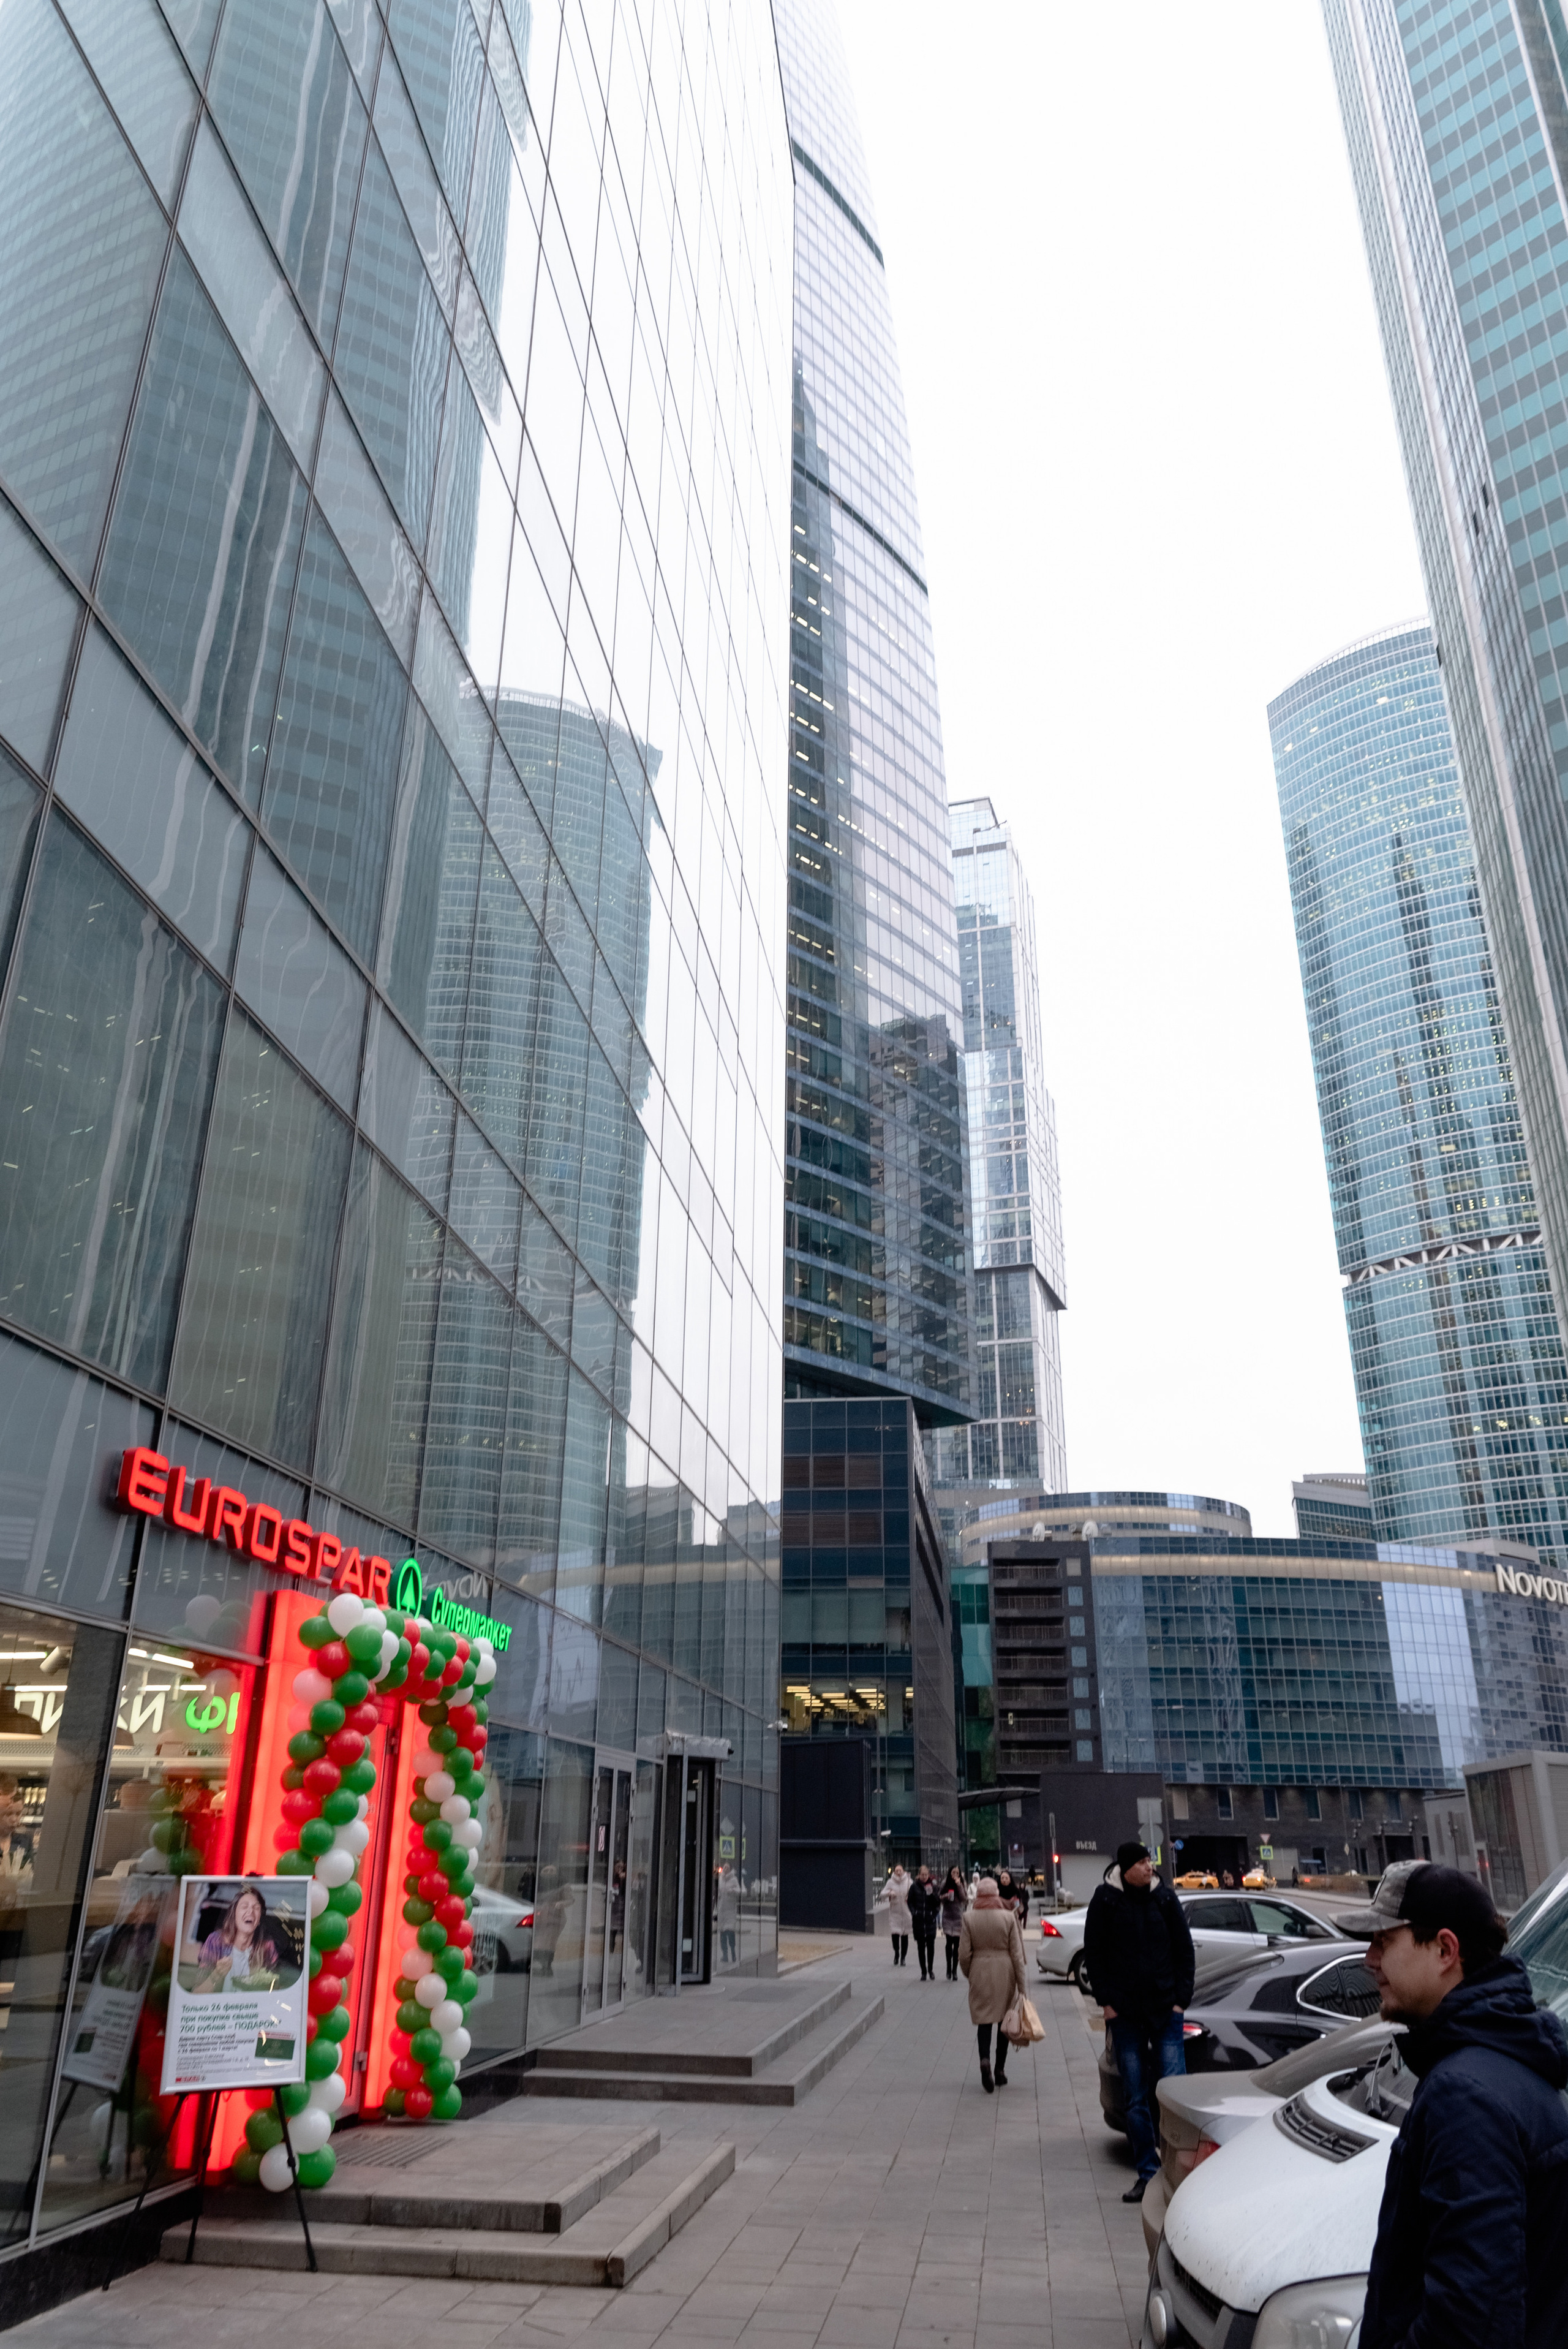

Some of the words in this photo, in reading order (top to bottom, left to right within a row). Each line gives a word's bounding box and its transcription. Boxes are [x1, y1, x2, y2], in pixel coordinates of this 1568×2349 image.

[118, 1447, 391, 1610] EUROSPAR
[431, 1587, 512, 1652] Супермаркет
[1076, 1840, 1096, 1851] ВЪЕЗД
[182, 2003, 209, 2013] Только
[211, 2003, 221, 2011] 26
[222, 2002, 258, 2013] февраля
[180, 2015, 196, 2024] при
[198, 2014, 230, 2023] покупке
[232, 2011, 259, 2020] свыше
[180, 2024, 195, 2034] 700
[197, 2022, 226, 2033] рублей
